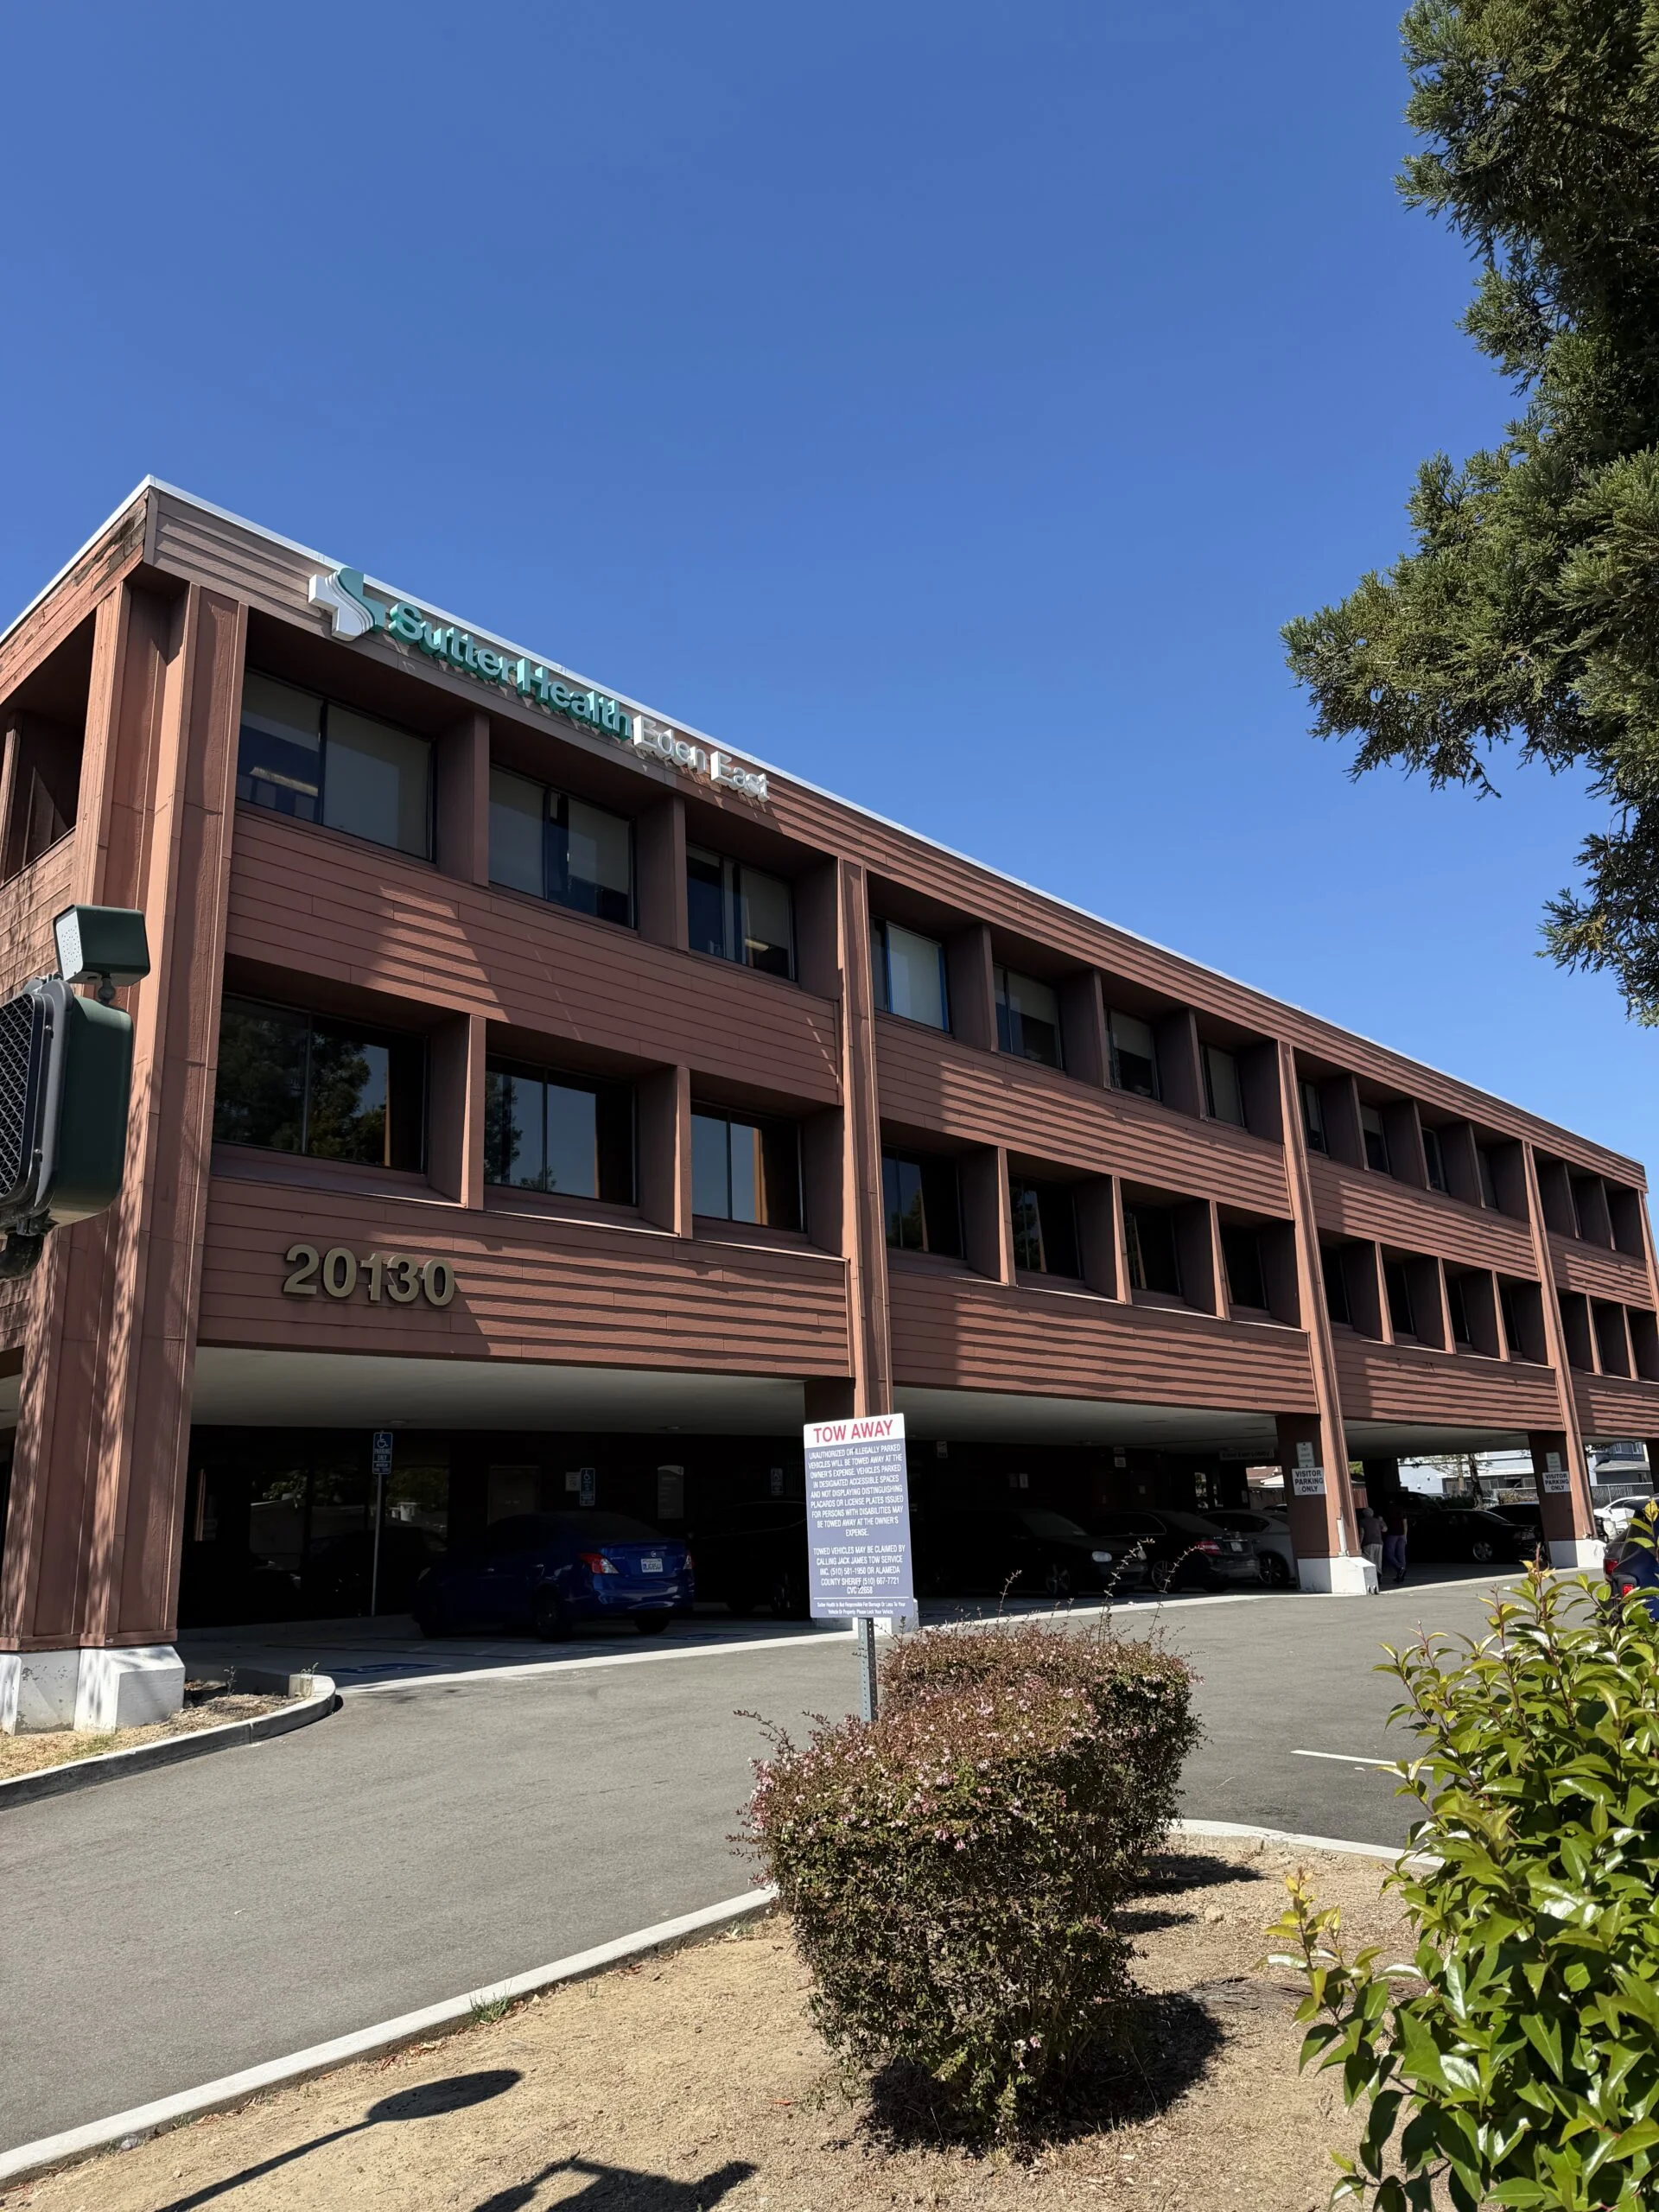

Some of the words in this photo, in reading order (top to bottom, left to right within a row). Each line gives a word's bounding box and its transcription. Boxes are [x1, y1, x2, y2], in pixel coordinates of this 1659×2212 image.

[388, 601, 518, 687] Sutter
[518, 658, 633, 741] Health
[633, 715, 707, 773] Eden
[710, 751, 770, 803] East
[283, 1244, 454, 1306] 20130
[813, 1425, 847, 1443] TOW
[851, 1420, 893, 1440] AWAY
[809, 1450, 845, 1459] UNAUTHORIZED
[855, 1446, 880, 1455] ILLEGALLY
[809, 1461, 830, 1470] VEHICLES
[852, 1457, 868, 1465] TOWED
[857, 1466, 880, 1475] VEHICLES
[819, 1478, 848, 1487] DESIGNATED
[849, 1477, 879, 1485] ACCESSIBLE
[833, 1488, 861, 1497] DISPLAYING
[862, 1485, 902, 1495] DISTINGUISHING
[845, 1497, 864, 1506] LICENSE
[860, 1507, 891, 1516] DISABILITIES
[830, 1567, 842, 1576] (510)
[843, 1567, 866, 1575] 581-1950
[862, 1577, 875, 1586] (510)
